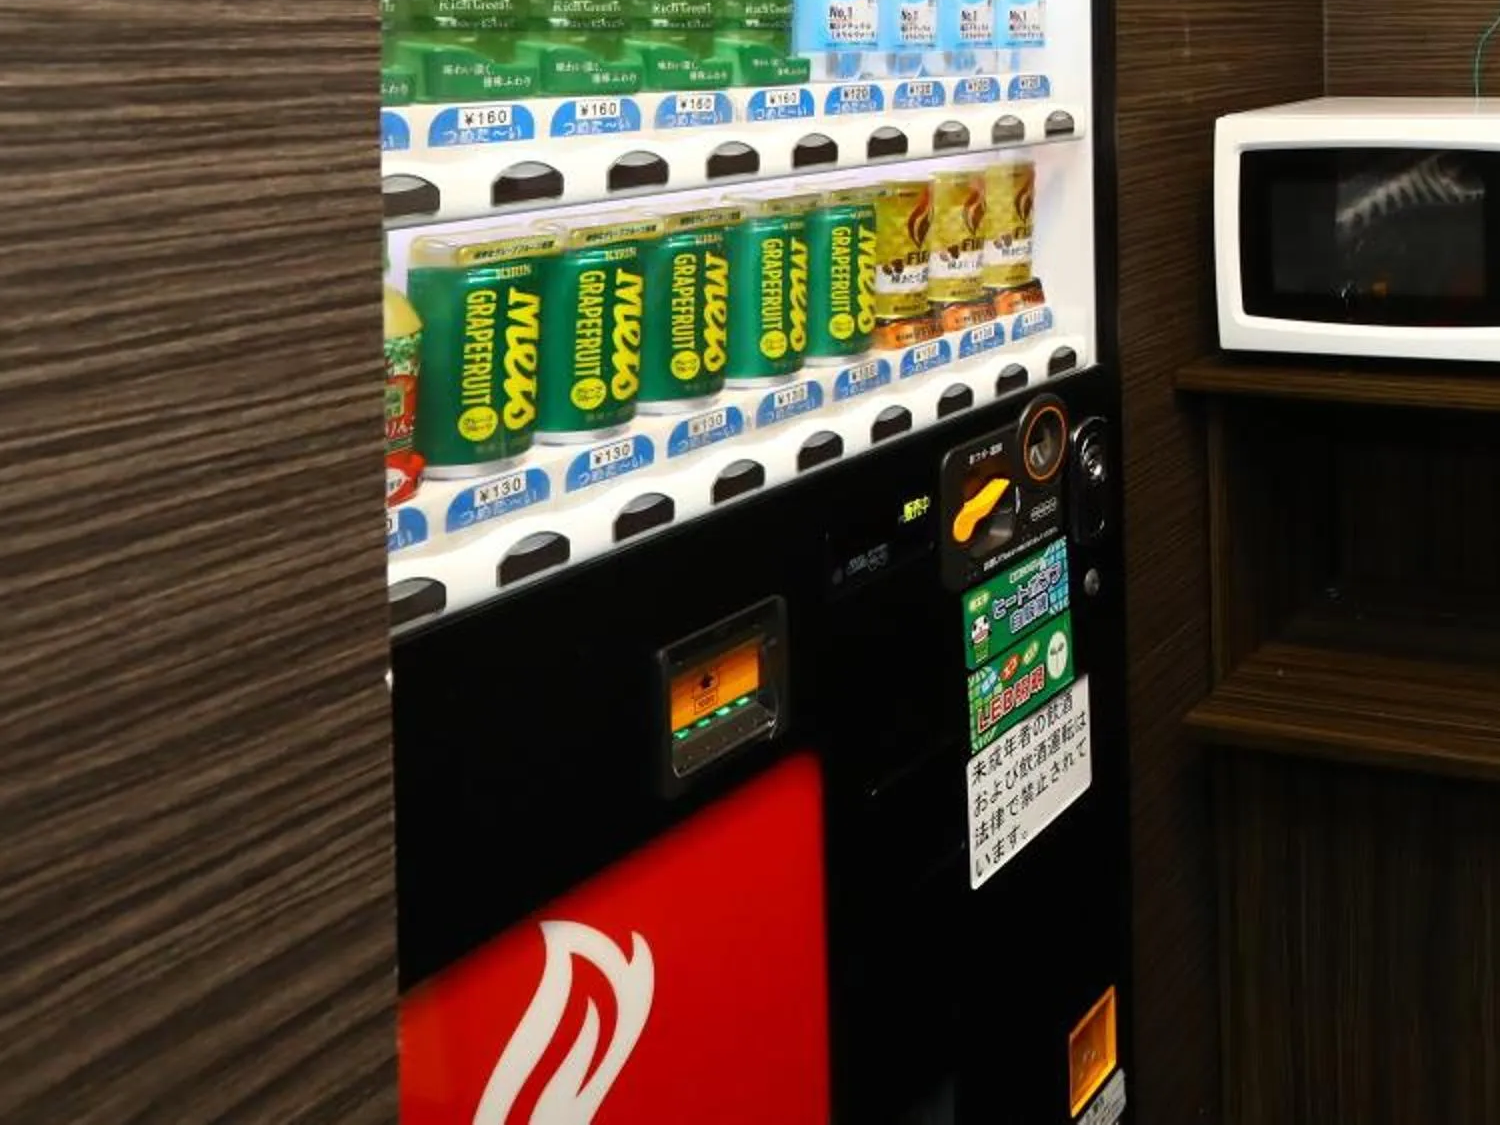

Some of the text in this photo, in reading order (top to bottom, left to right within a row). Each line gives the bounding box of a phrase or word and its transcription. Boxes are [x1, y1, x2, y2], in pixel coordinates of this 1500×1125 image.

[465, 110, 507, 125] ¥160
[580, 102, 617, 116] ¥160
[681, 98, 712, 110] ¥160
[671, 253, 697, 349] GRAPEFRUIT
[761, 238, 784, 330] GRAPEFRUIT
[831, 226, 851, 312] GRAPEFRUIT
[462, 290, 497, 405] GRAPEFRUIT
[574, 270, 606, 376] GRAPEFRUIT
[594, 444, 632, 465] ¥130
[692, 414, 723, 433] ¥130
[478, 477, 521, 503] ¥130
[972, 691, 1074, 784] 未成年者の飲酒
[974, 711, 1087, 818] および飲酒運転は
[974, 737, 1087, 848] 法律で禁止されて
[975, 824, 1029, 877] います。
